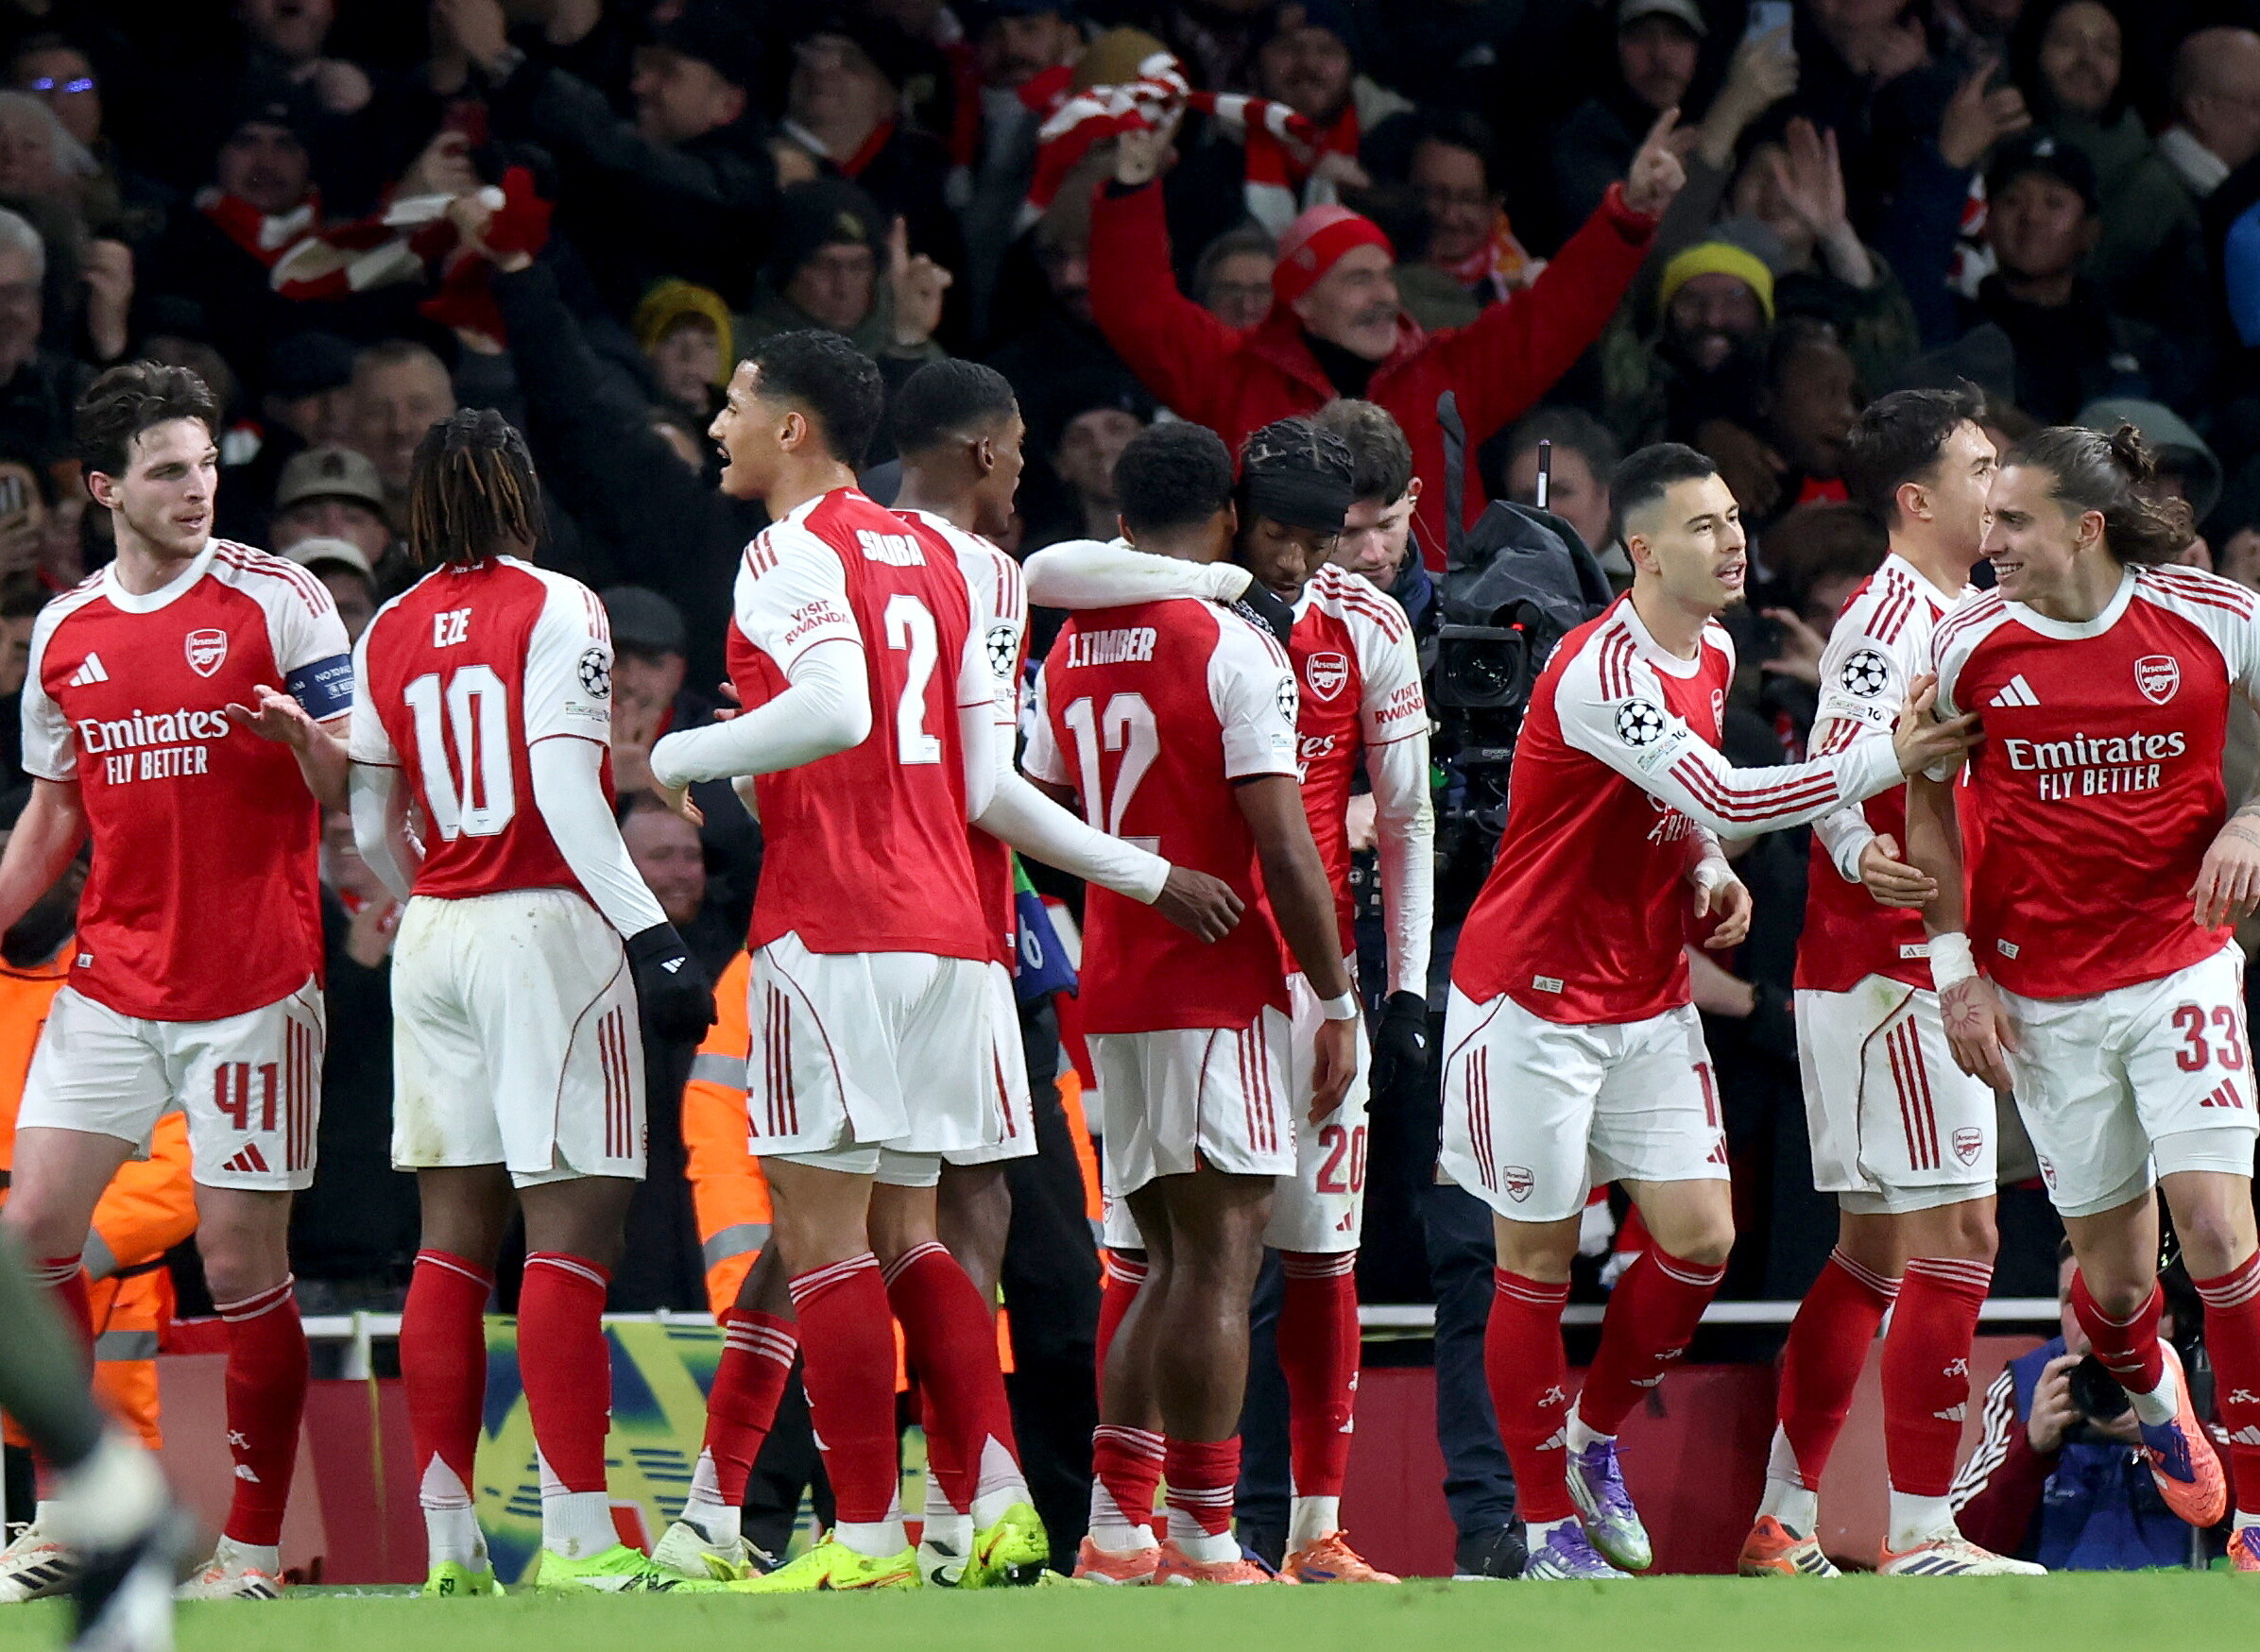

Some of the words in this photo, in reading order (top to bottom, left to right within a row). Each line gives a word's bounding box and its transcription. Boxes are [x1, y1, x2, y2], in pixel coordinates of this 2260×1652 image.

[434, 607, 472, 648] EZE
[785, 612, 850, 646] RWANDA
[791, 600, 829, 622] VISIT
[1067, 627, 1157, 669] J.TIMBER
[2141, 663, 2173, 673] Arsenal
[883, 593, 941, 765] 2
[1375, 696, 1423, 724] RWAND
[77, 707, 231, 755] Emirates
[2004, 731, 2186, 771] Emirates
[106, 753, 135, 785] FLY
[141, 744, 208, 781] BETTER
[403, 664, 516, 842] 10
[1064, 692, 1160, 855] 12
[2039, 772, 2074, 801] FLY
[2082, 764, 2160, 796] BETTER
[2171, 1004, 2244, 1073] 33
[214, 1062, 279, 1133] 41
[1316, 1124, 1365, 1194] 20
